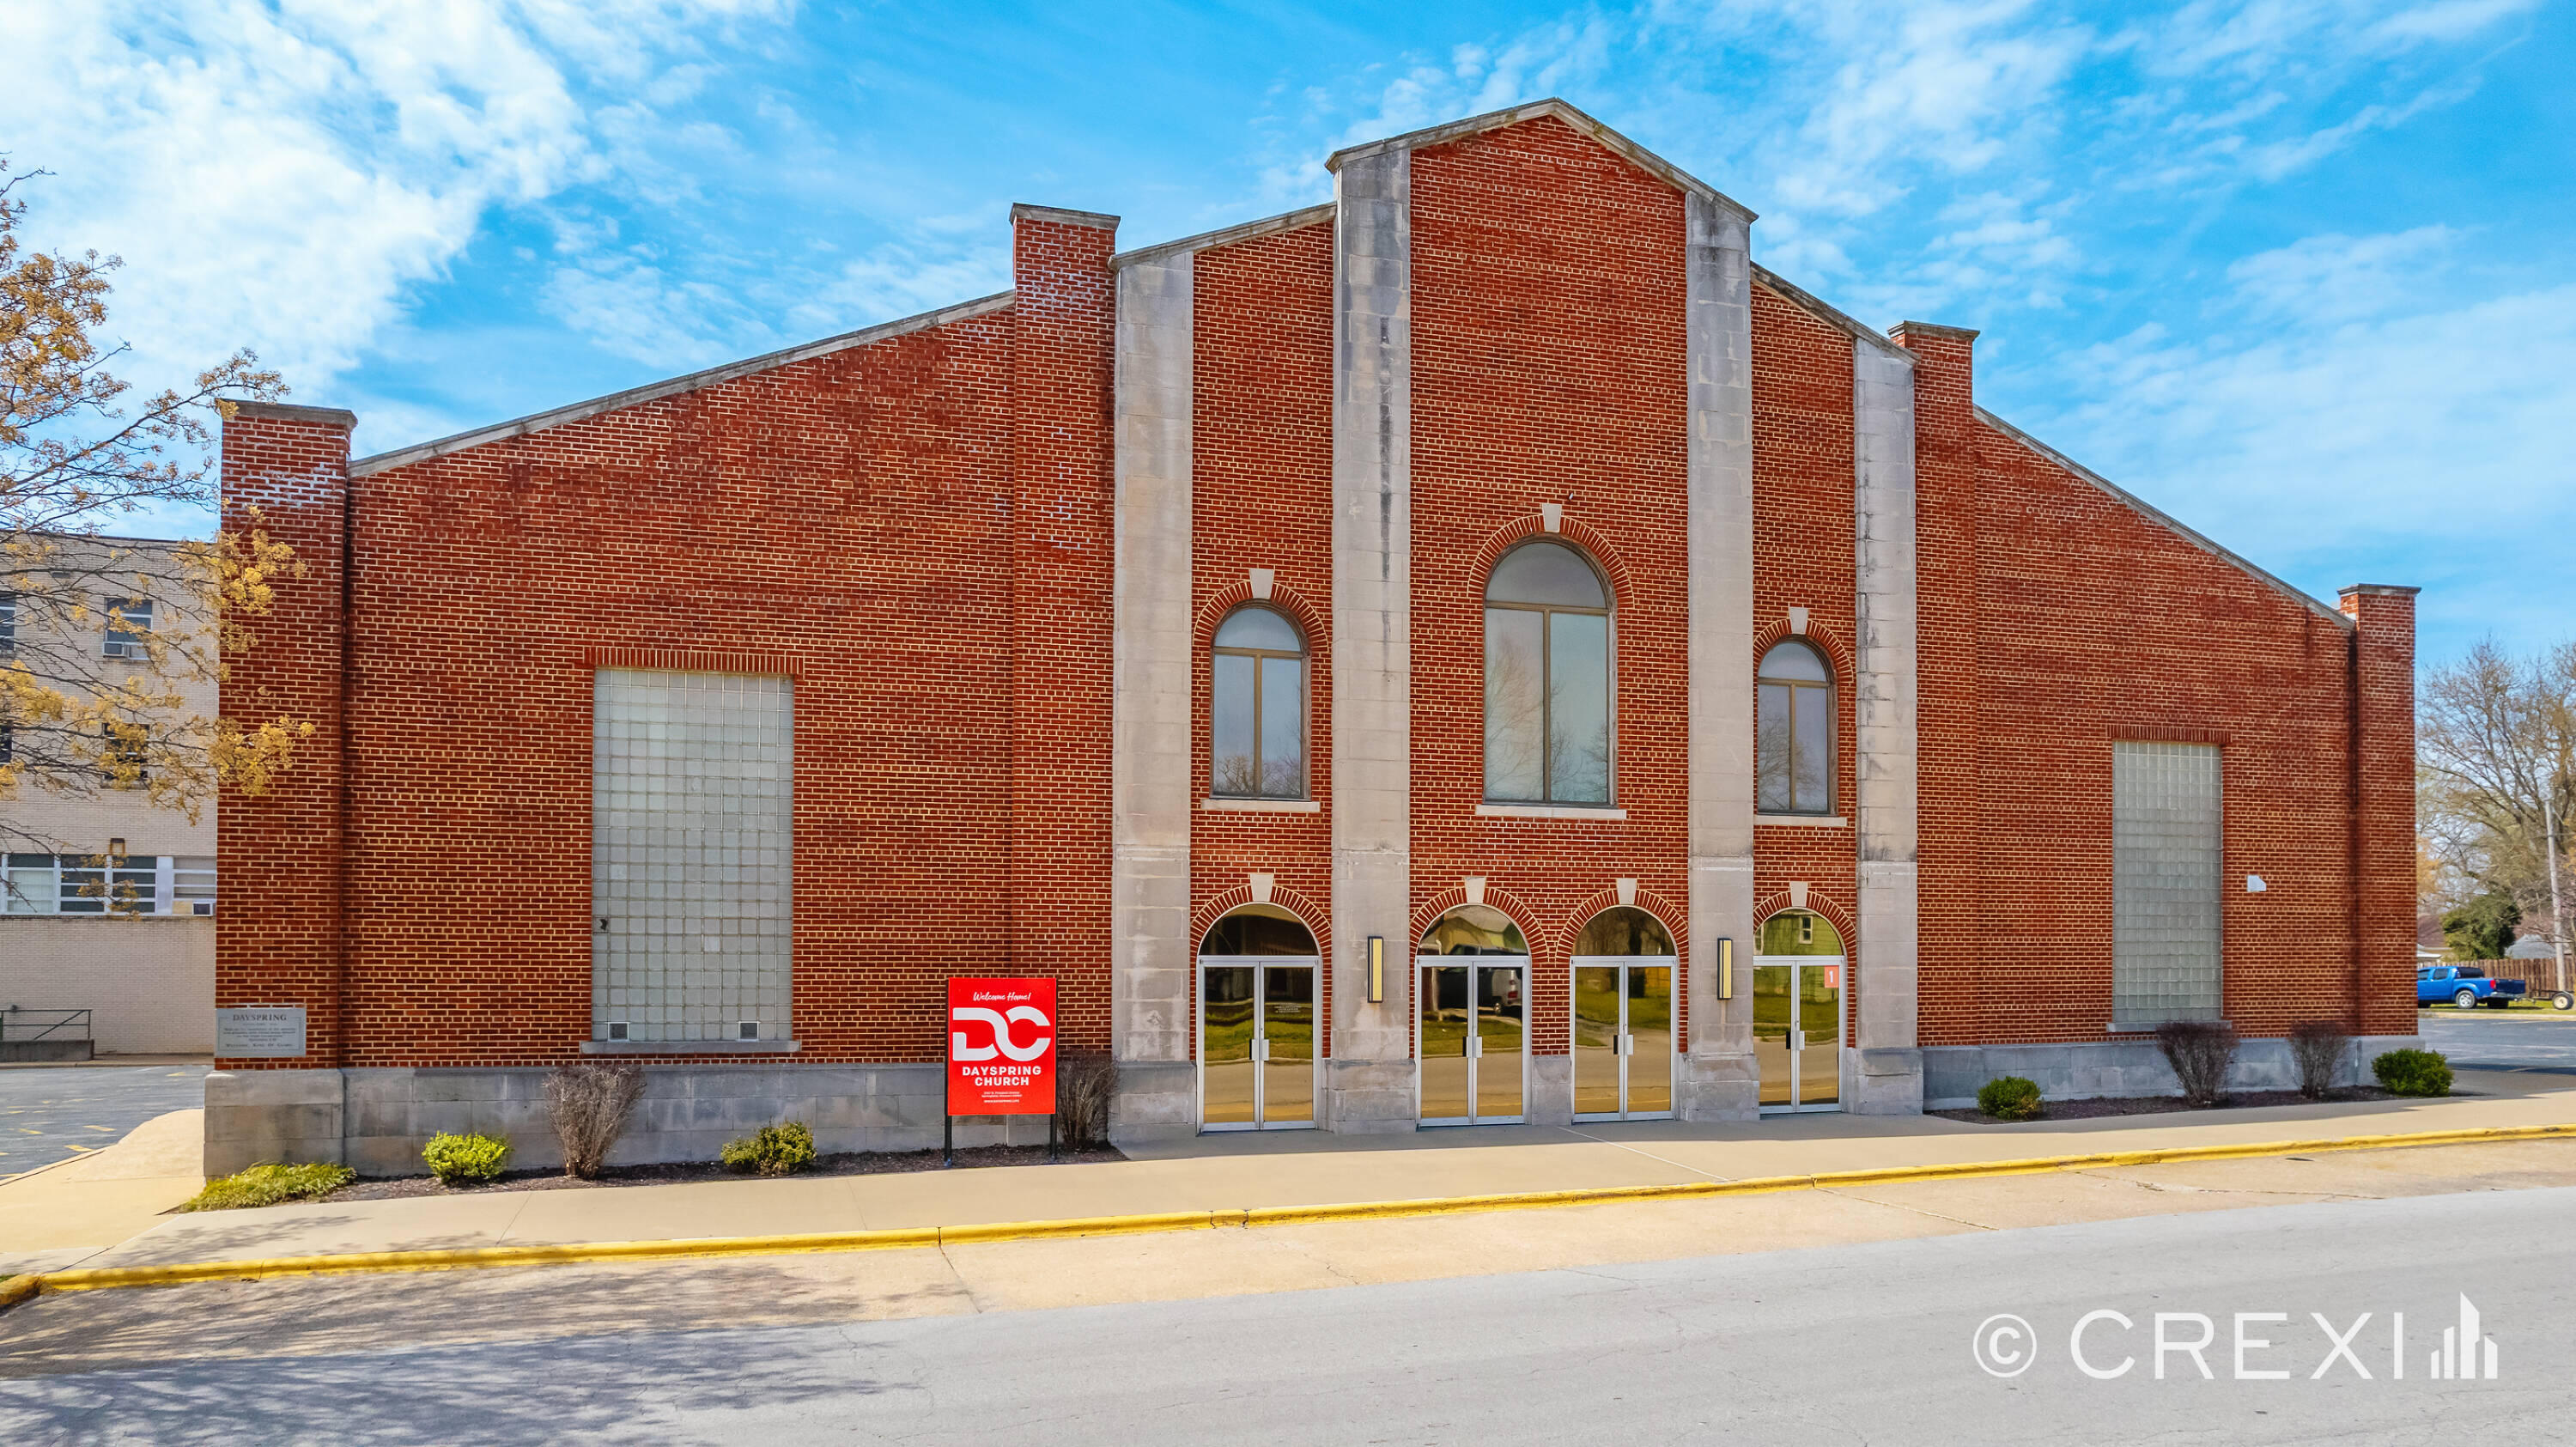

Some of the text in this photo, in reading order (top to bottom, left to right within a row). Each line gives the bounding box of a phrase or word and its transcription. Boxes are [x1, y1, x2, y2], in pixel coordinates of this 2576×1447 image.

[973, 991, 1031, 1001] Welcome Home!
[952, 1006, 1051, 1061] DC
[962, 1066, 1042, 1076] DAYSPRING
[975, 1077, 1030, 1086] CHURCH
